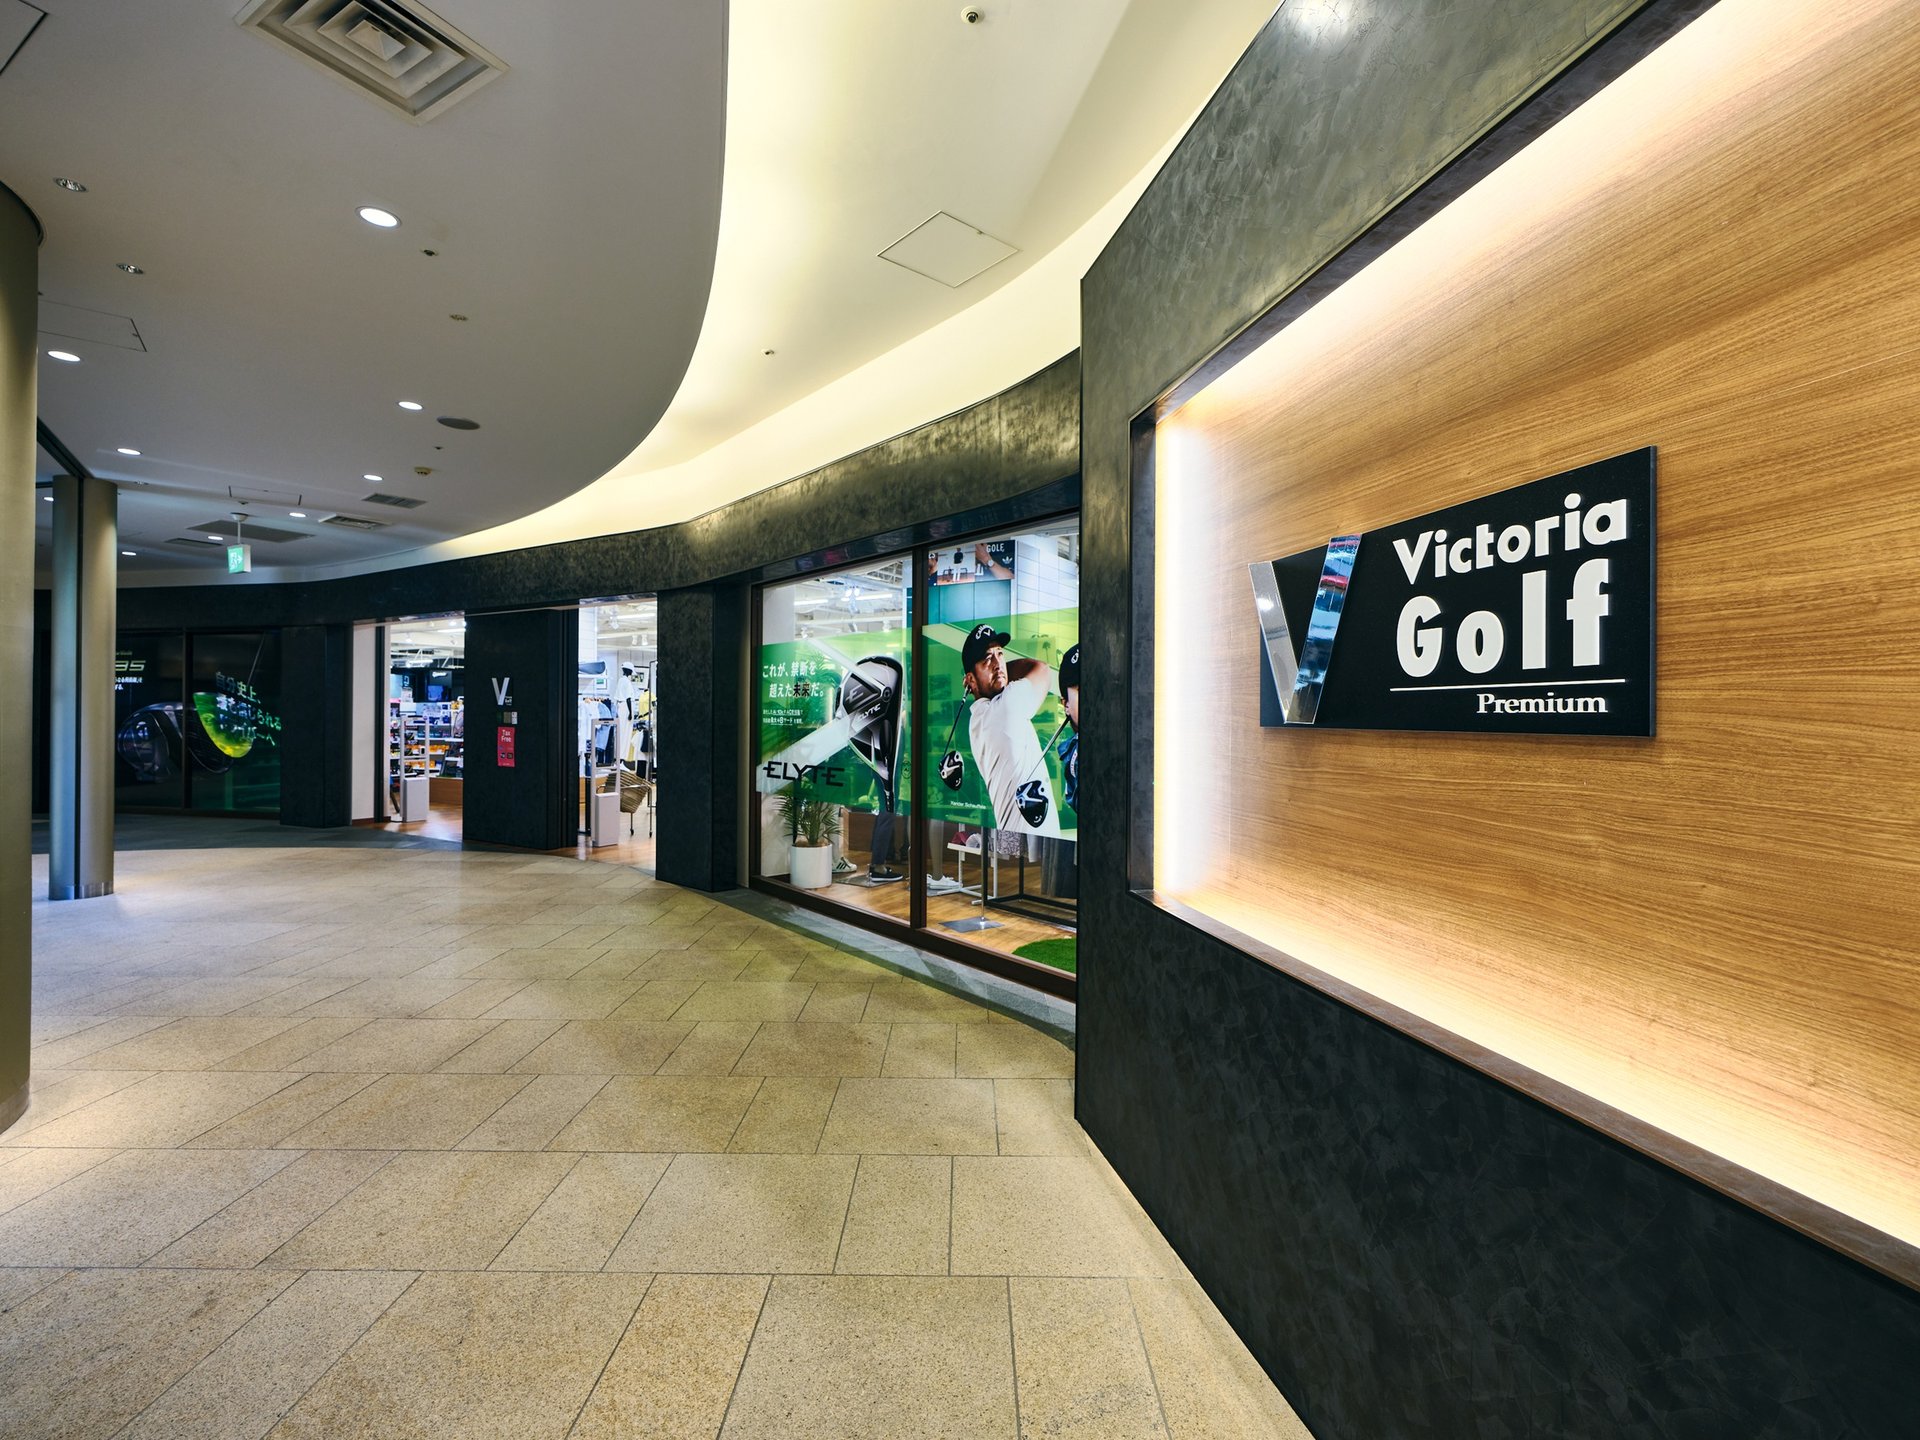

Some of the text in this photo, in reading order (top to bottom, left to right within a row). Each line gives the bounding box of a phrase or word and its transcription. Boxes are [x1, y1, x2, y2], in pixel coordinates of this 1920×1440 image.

[1392, 493, 1627, 584] Victoria
[1397, 558, 1609, 677] Golf
[1476, 692, 1608, 714] Premium
[763, 761, 845, 787] ELYTE
